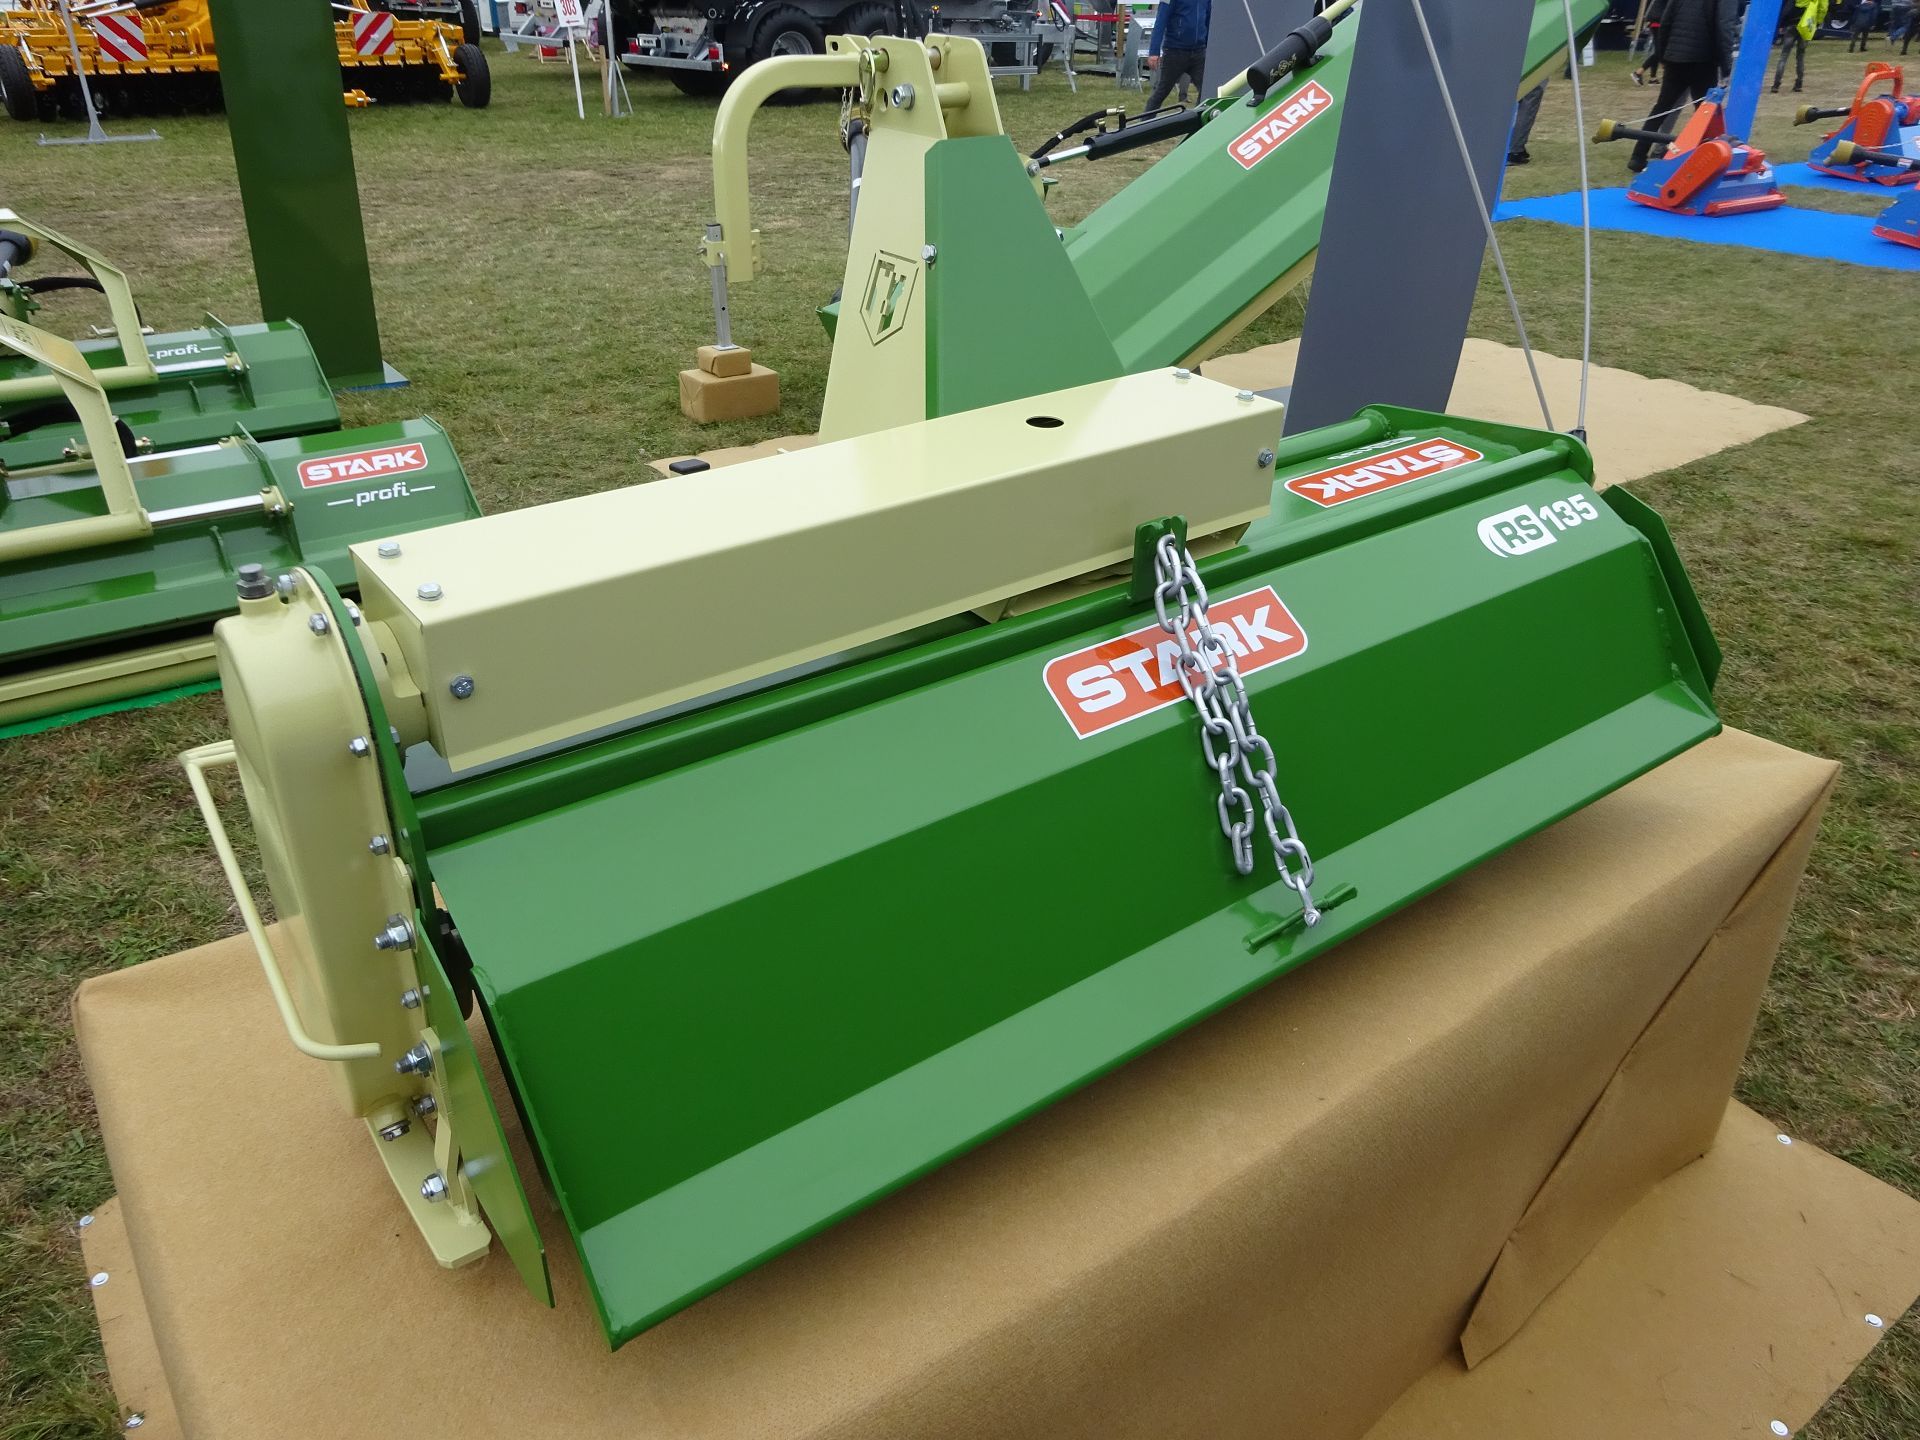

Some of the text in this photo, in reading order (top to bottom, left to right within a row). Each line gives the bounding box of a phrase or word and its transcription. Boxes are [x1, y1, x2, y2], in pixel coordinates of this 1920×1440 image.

[1236, 88, 1327, 160] STARK
[156, 343, 201, 360] profi
[306, 449, 421, 481] STARK
[1298, 445, 1466, 499] STARK
[356, 481, 410, 507] profi
